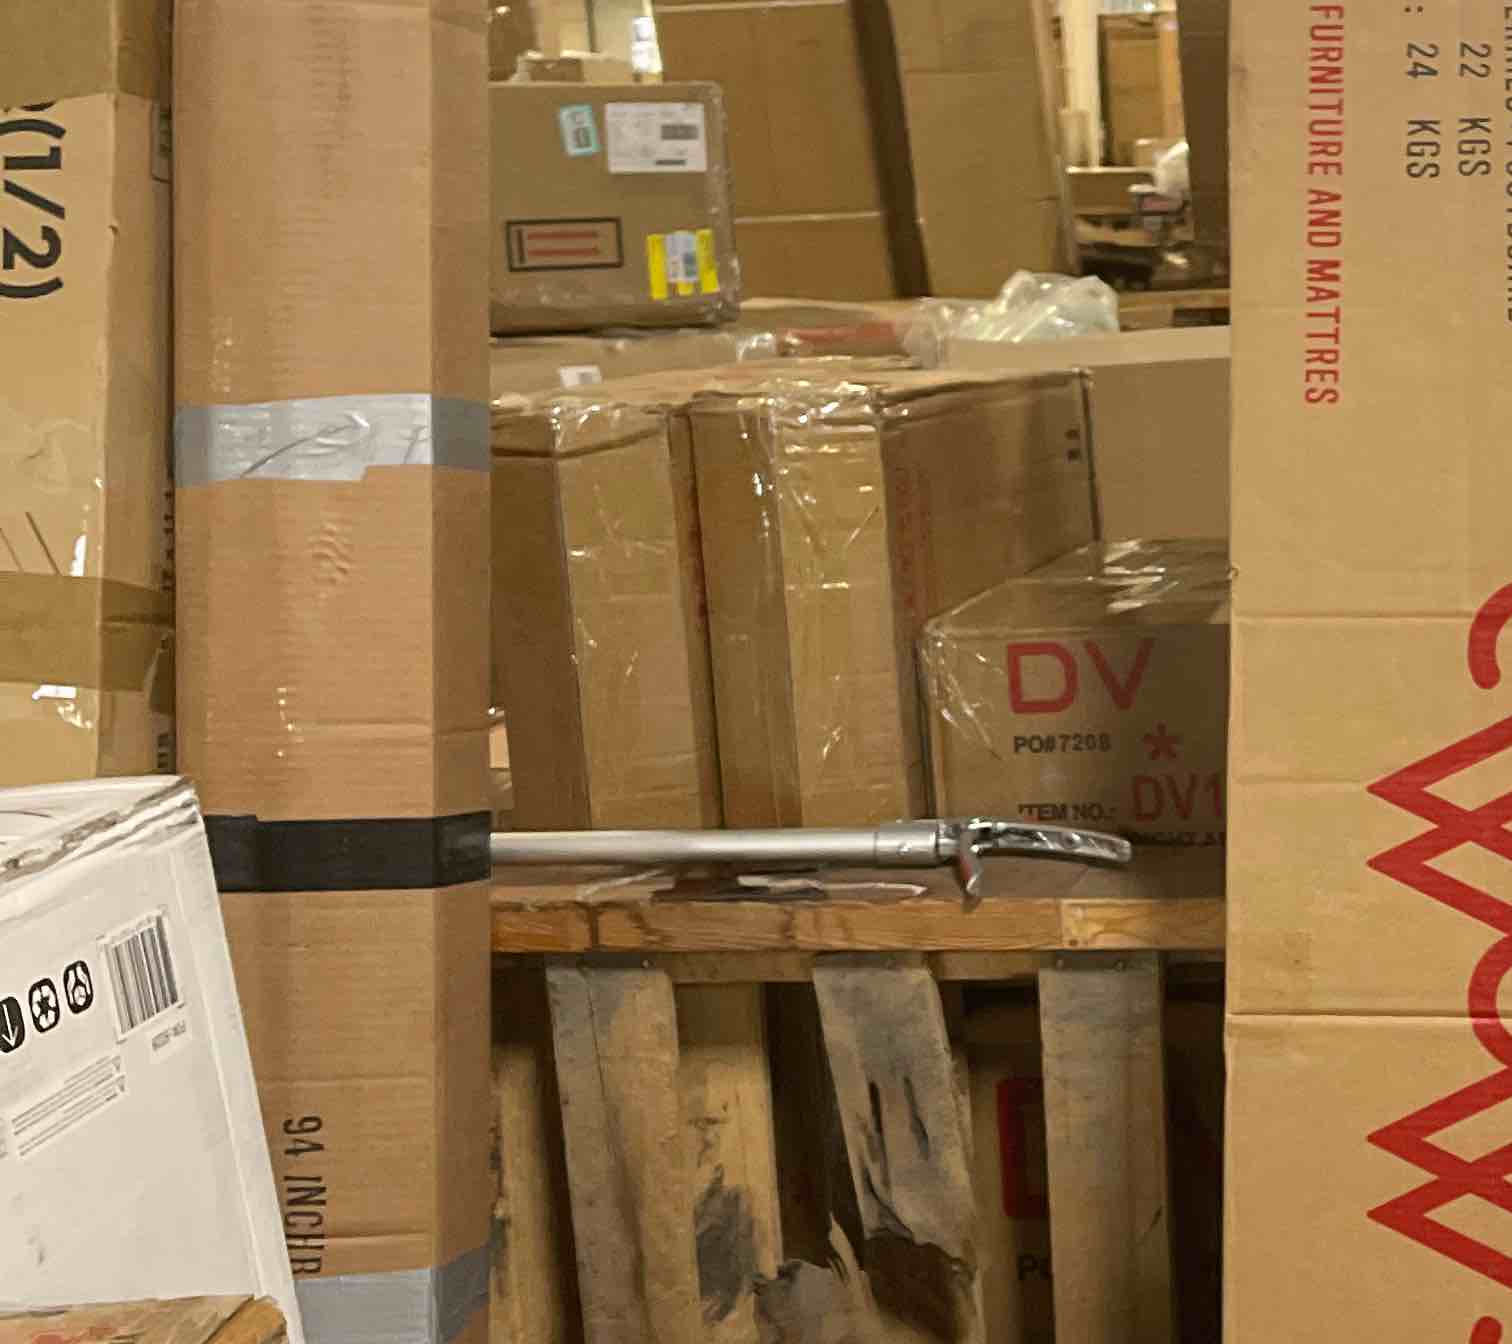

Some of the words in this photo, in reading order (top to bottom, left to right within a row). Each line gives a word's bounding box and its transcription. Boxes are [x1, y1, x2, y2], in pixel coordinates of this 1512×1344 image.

[1404, 41, 1440, 80] 24
[1458, 40, 1492, 79] 22
[1307, 4, 1345, 177] FURNITURE
[1405, 118, 1441, 180] KGS
[1457, 117, 1492, 178] KGS
[0, 100, 66, 300] (1/2)
[1306, 188, 1343, 249] AND
[1304, 257, 1341, 406] MATTRES
[1006, 638, 1156, 714] DV
[282, 1115, 325, 1158] 94
